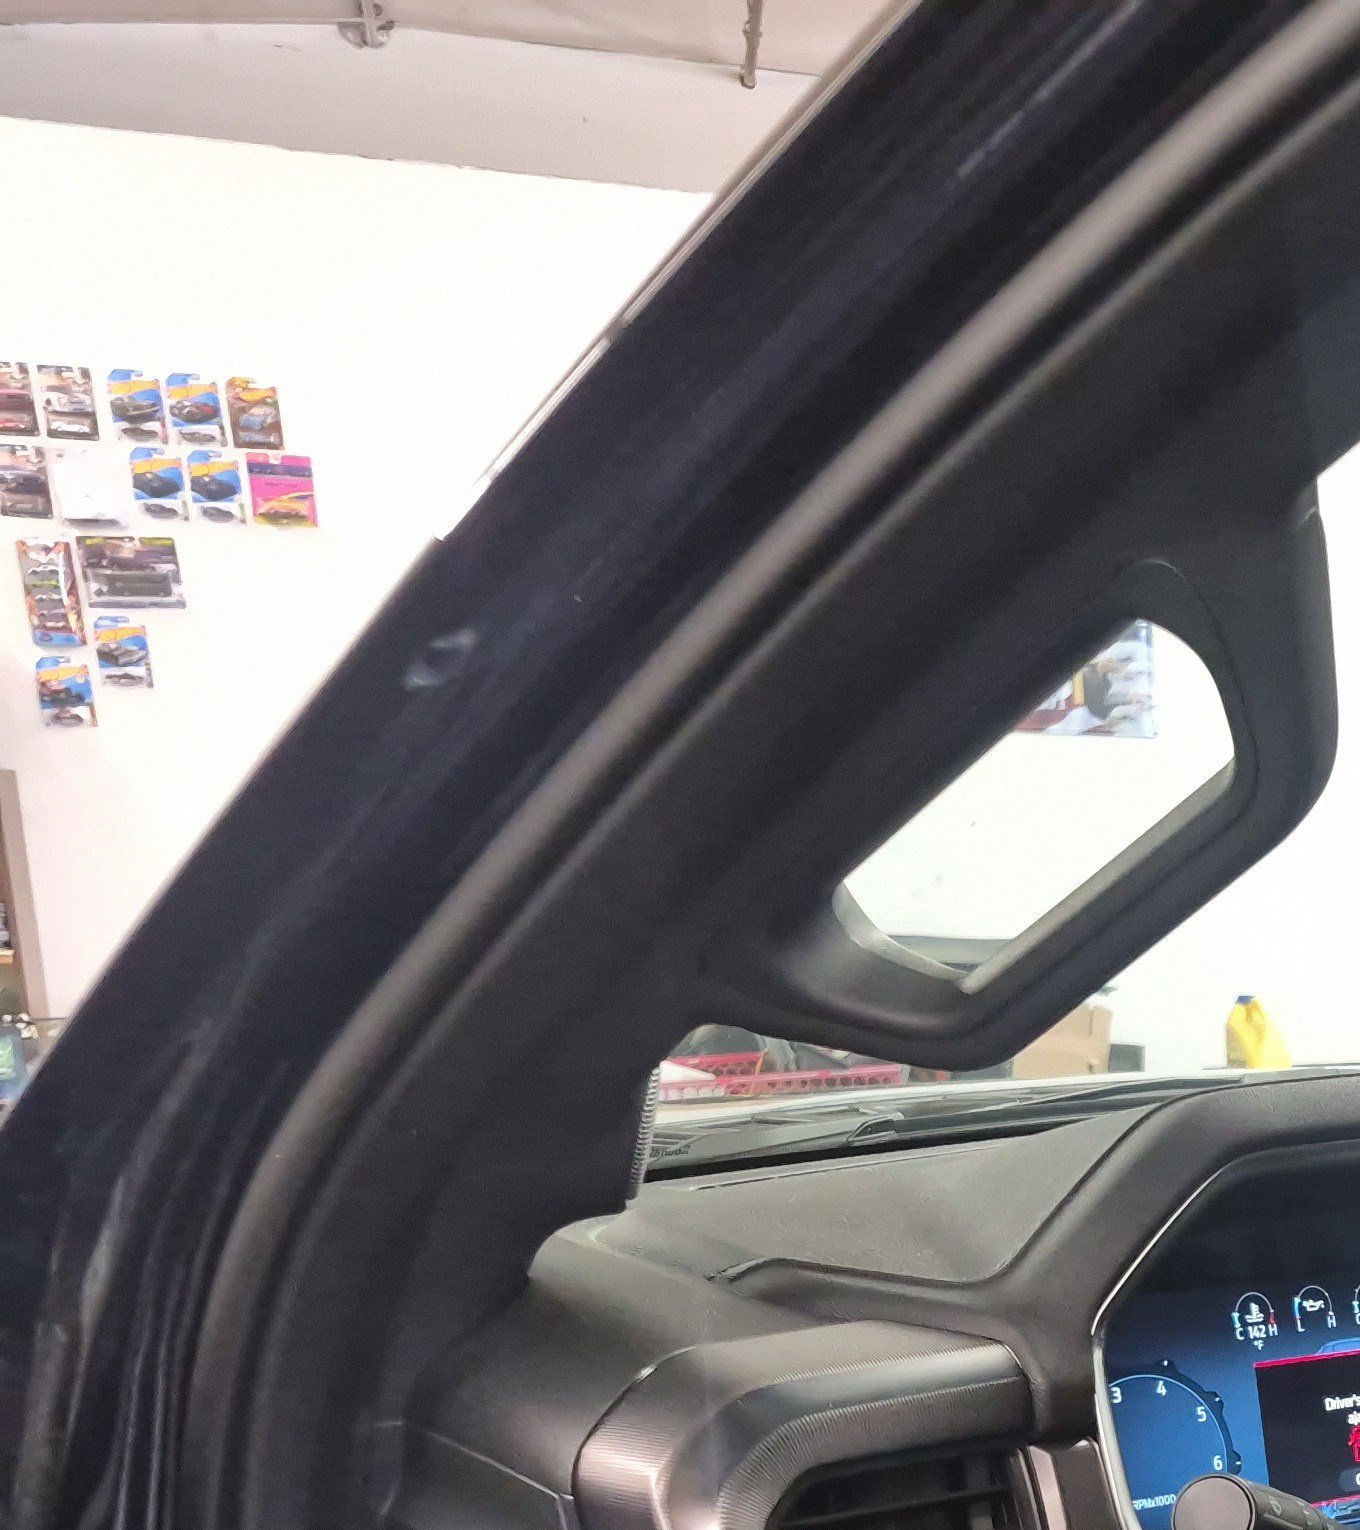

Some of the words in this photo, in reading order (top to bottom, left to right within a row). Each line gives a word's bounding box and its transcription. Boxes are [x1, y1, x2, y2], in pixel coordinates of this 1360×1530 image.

[1327, 1315, 1337, 1329] H
[1235, 1327, 1245, 1341] C
[1247, 1325, 1267, 1340] 142
[1268, 1323, 1279, 1337] H
[1111, 1386, 1122, 1404] 3
[1156, 1380, 1167, 1396] 4
[1197, 1406, 1207, 1422] 5
[1213, 1455, 1223, 1471] 6
